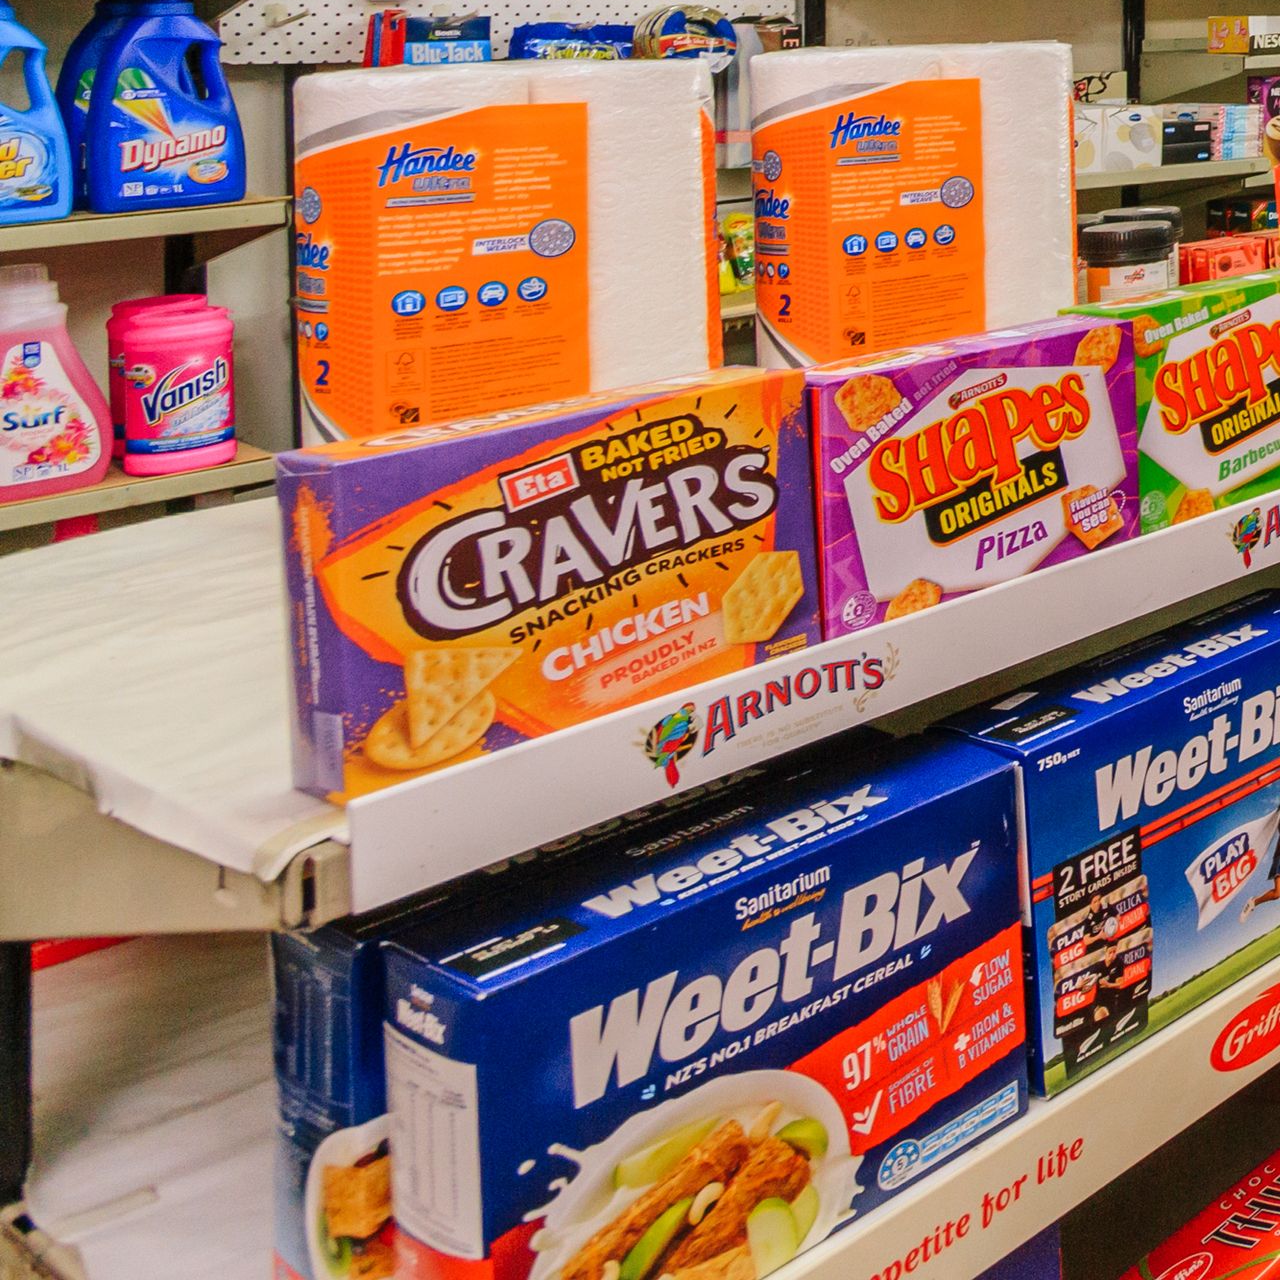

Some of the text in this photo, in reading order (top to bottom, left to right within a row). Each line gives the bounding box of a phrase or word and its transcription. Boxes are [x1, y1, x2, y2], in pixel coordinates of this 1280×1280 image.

[411, 42, 484, 64] Blu-Tack
[120, 125, 226, 172] Dynamo
[830, 112, 901, 148] Handee
[857, 140, 898, 152] Ultra
[378, 143, 476, 187] Handee
[412, 176, 471, 192] Ultra
[901, 190, 938, 200] INTERLOCK
[475, 235, 526, 248] INTERLOCK
[778, 295, 791, 316] 2
[142, 359, 227, 422] Vanish
[316, 360, 330, 386] 2
[2, 405, 65, 430] Surf
[829, 360, 959, 475] Oven Baked not fried
[581, 418, 695, 471] BAKED
[602, 432, 722, 482] NOT FRIED
[515, 469, 567, 500] Eta
[939, 462, 1059, 534] ORIGINALS
[406, 451, 776, 630] CRAVERS
[975, 519, 1049, 571] Pizza
[509, 538, 745, 644] SNACKING CRACKERS
[540, 591, 710, 682] CHICKEN
[600, 630, 696, 689] PROUDLY
[630, 637, 717, 687] BAKED IN NZ
[1071, 623, 1268, 705] Weet-Bix
[702, 652, 886, 756] ARNOTT'S
[1183, 678, 1242, 716] Sanitarium
[582, 784, 889, 919] Weet-Bix
[1058, 833, 1137, 897] 2 FREE
[1204, 835, 1247, 878] PLAY
[735, 864, 831, 920] Sanitarium
[1215, 855, 1252, 898] BIG
[1116, 893, 1142, 915] SELICA
[570, 846, 979, 1109] Weet-Bix
[972, 969, 1013, 1006] SUGAR
[664, 954, 914, 1090] NZ'S NO.1 BREAKFAST CEREAL
[887, 1021, 930, 1061] GRAIN
[967, 1020, 1017, 1063] VITAMINS
[971, 1013, 1000, 1042] IRON
[887, 1074, 936, 1114] FIBRE
[981, 1137, 1086, 1229] for life
[1220, 1164, 1276, 1210] CHOC
